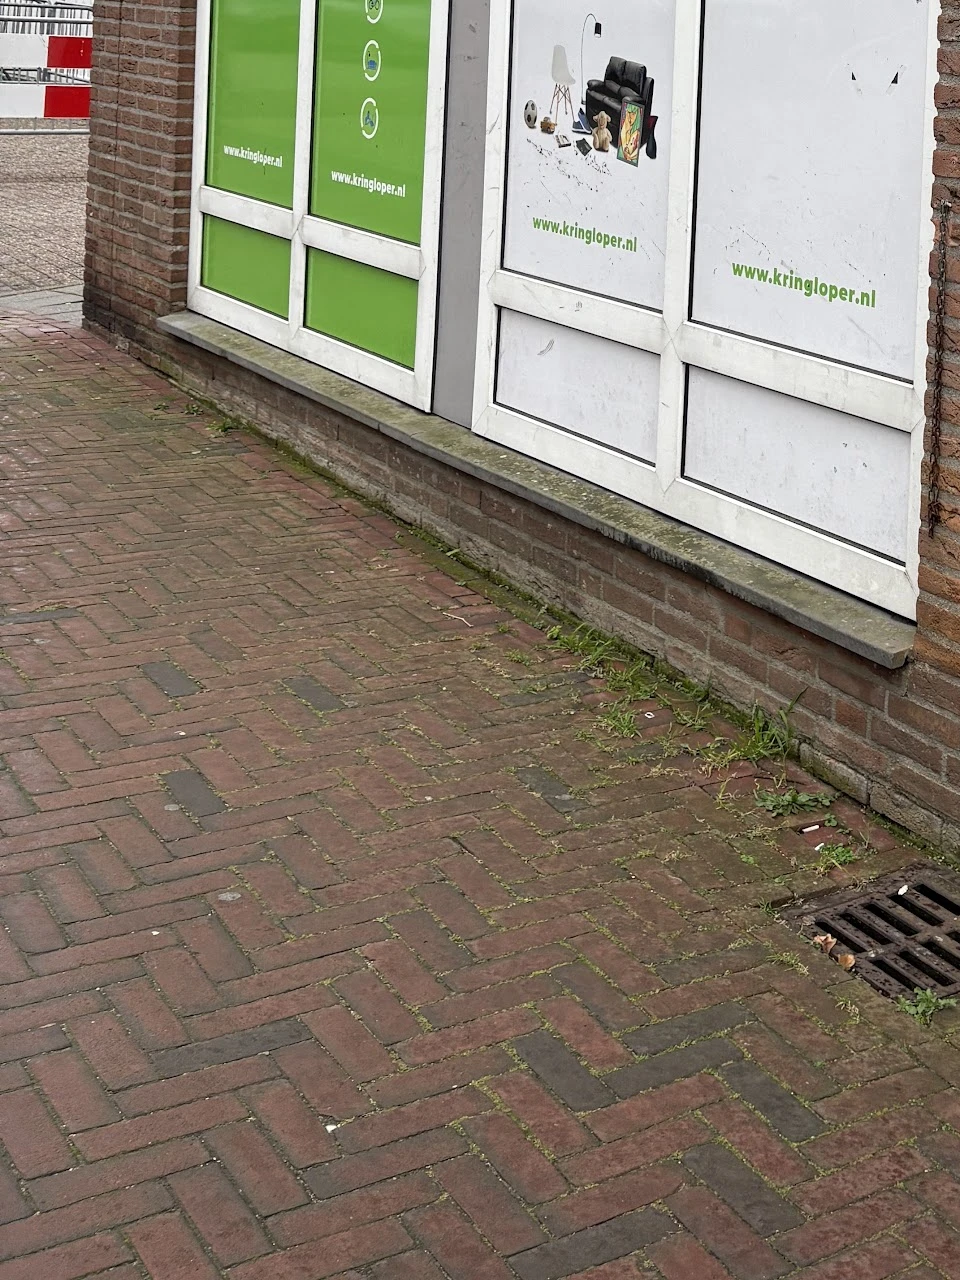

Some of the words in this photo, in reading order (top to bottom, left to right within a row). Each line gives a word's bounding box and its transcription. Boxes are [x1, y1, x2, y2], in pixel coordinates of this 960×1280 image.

[223, 144, 283, 168] www.kringloper.nl
[331, 170, 406, 198] www.kringloper.nl
[532, 216, 638, 253] www.kringloper.nl
[731, 261, 877, 308] www.kringloper.nl
